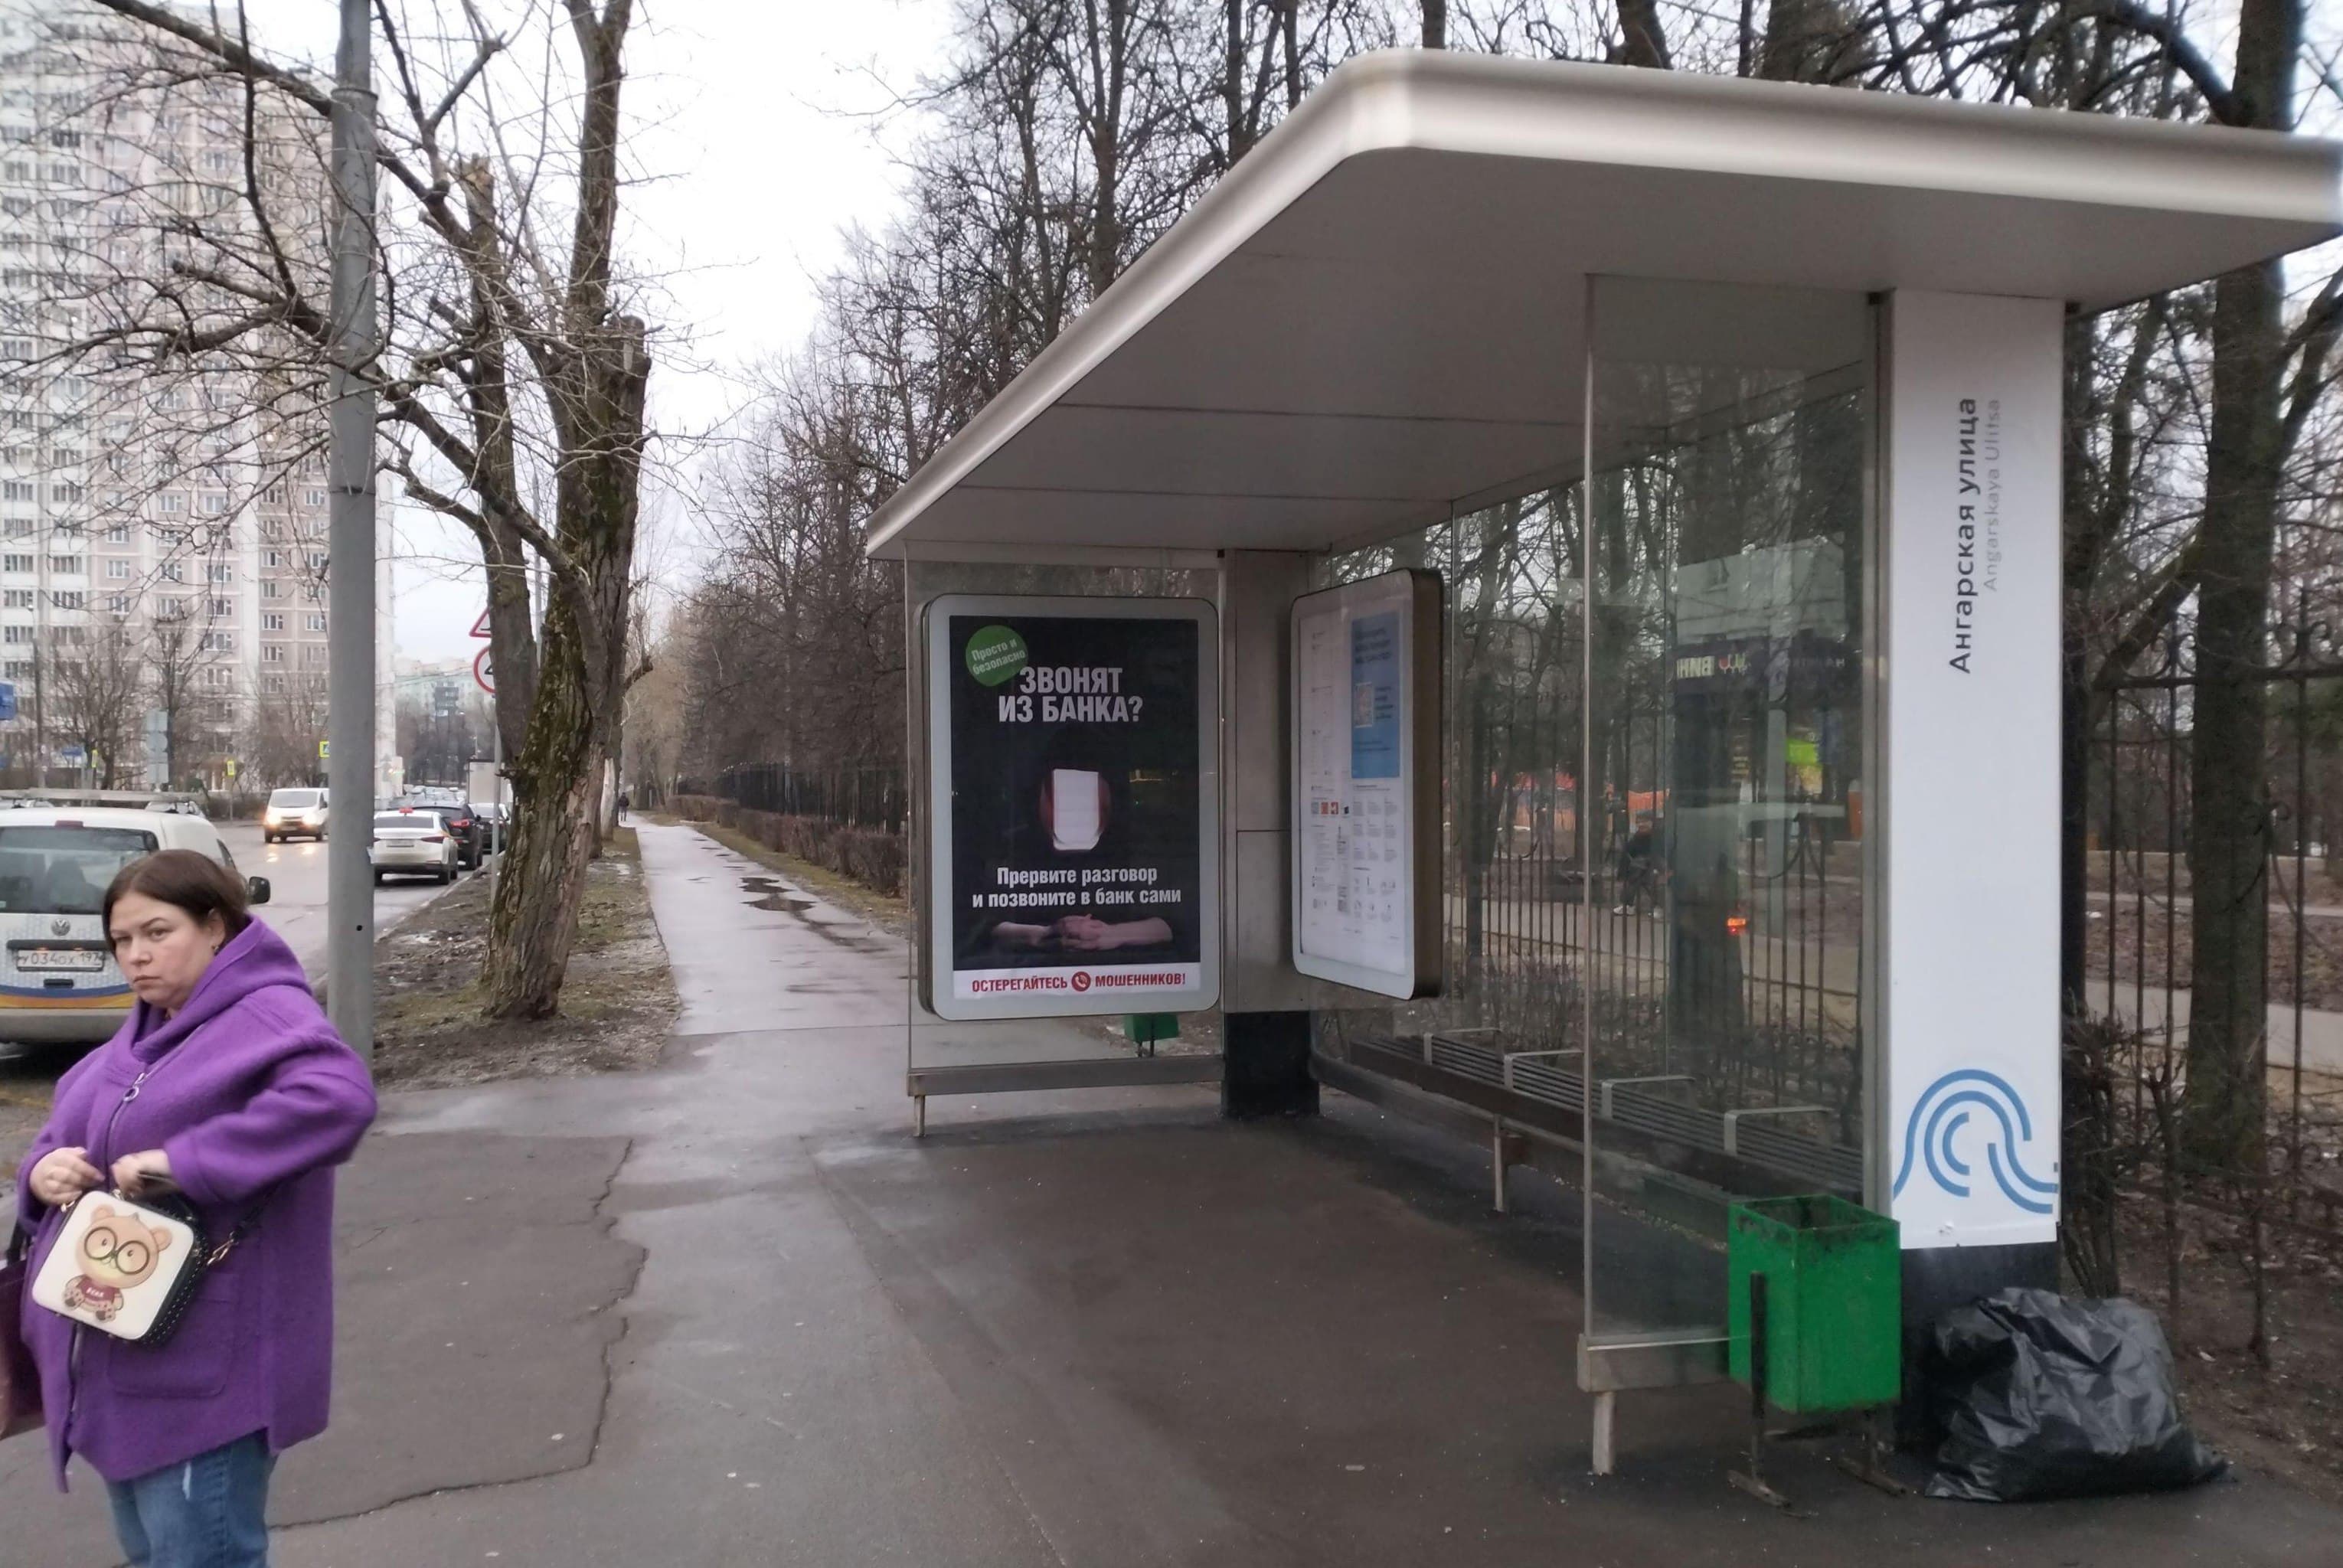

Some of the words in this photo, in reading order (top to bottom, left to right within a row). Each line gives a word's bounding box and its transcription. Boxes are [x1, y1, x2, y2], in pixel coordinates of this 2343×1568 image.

[1984, 398, 2001, 460] Ulitsa
[1959, 397, 1981, 495] улица
[1983, 468, 2002, 593] Angarskaya
[1949, 504, 1979, 675] Ангарская
[971, 642, 1008, 662] Просто
[1009, 639, 1018, 648] и
[972, 649, 1026, 675] безопасно
[1019, 666, 1122, 694] ЗВОНЯТ
[998, 696, 1034, 723] ИЗ
[1042, 695, 1143, 722] БАНКА?
[997, 867, 1077, 887] Прервите
[1081, 867, 1158, 886] разговор
[972, 896, 983, 908] и
[989, 892, 1076, 908] позвоните
[1081, 892, 1090, 906] в
[1095, 888, 1135, 905] банк
[1139, 889, 1181, 903] сами
[972, 976, 1067, 993] ОСТЕРЕГАЙТЕСЬ
[1095, 973, 1186, 988] МОШЕННИКОВ!
